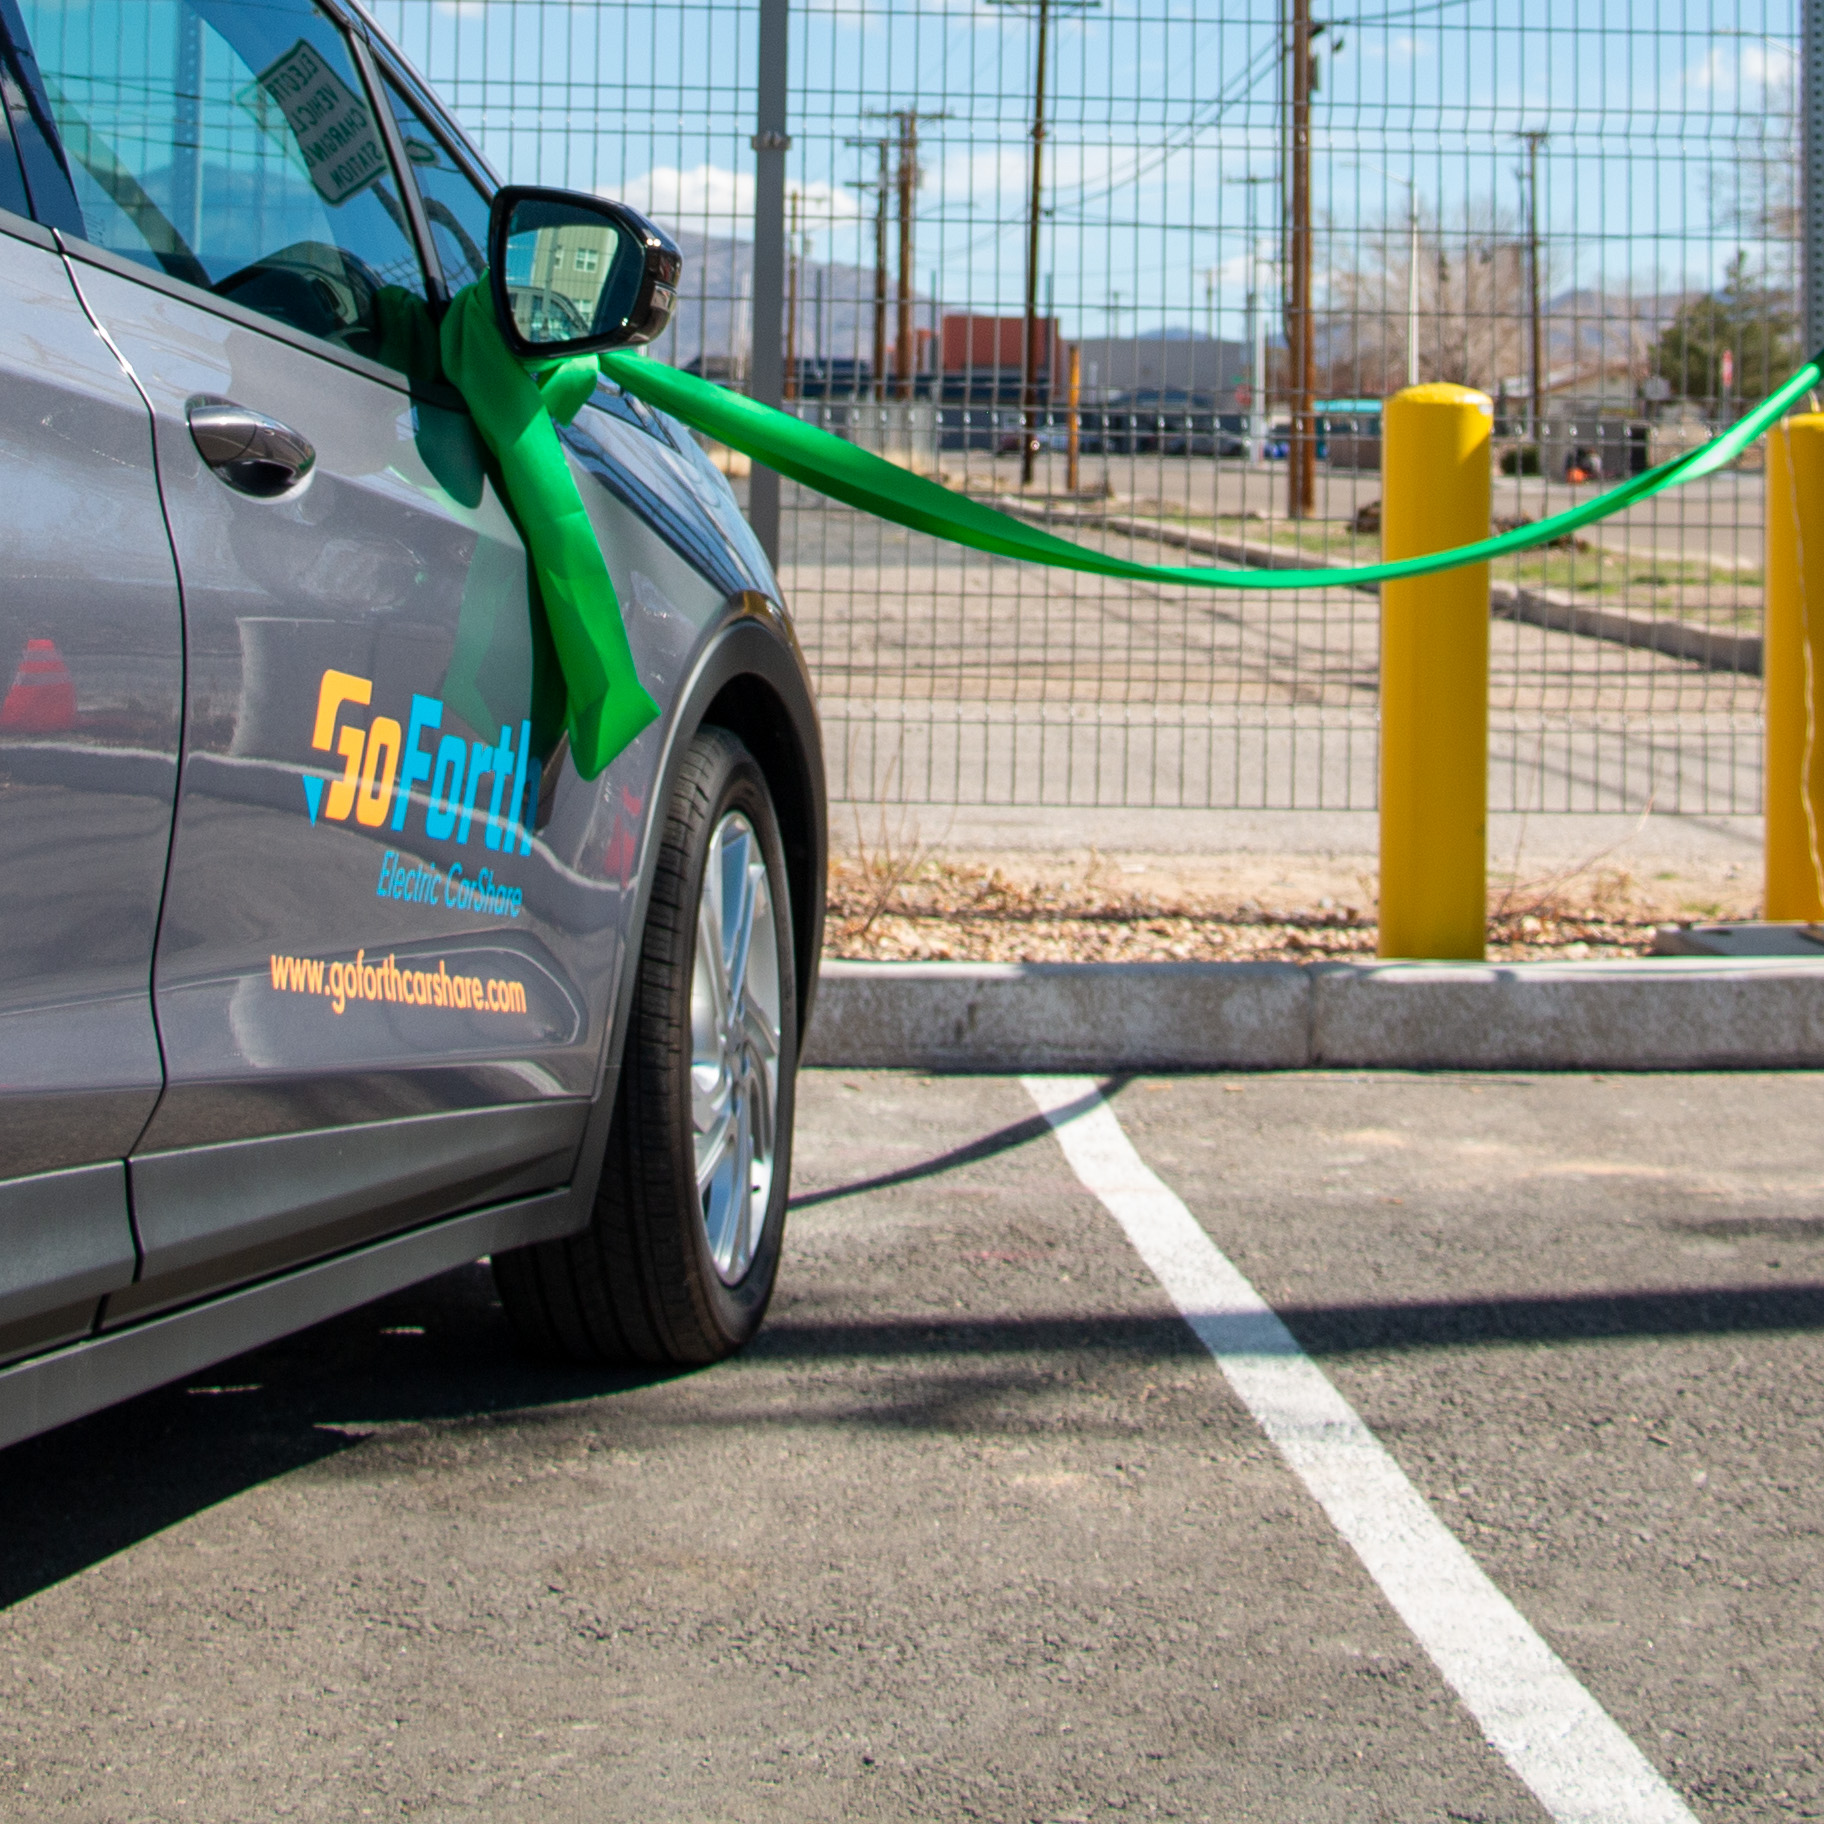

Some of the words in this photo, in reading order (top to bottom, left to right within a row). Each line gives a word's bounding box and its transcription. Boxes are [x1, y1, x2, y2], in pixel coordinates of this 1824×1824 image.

[376, 849, 443, 906] Electric
[444, 861, 523, 918] CarShare
[270, 948, 527, 1016] www.goforthcarshare.com
